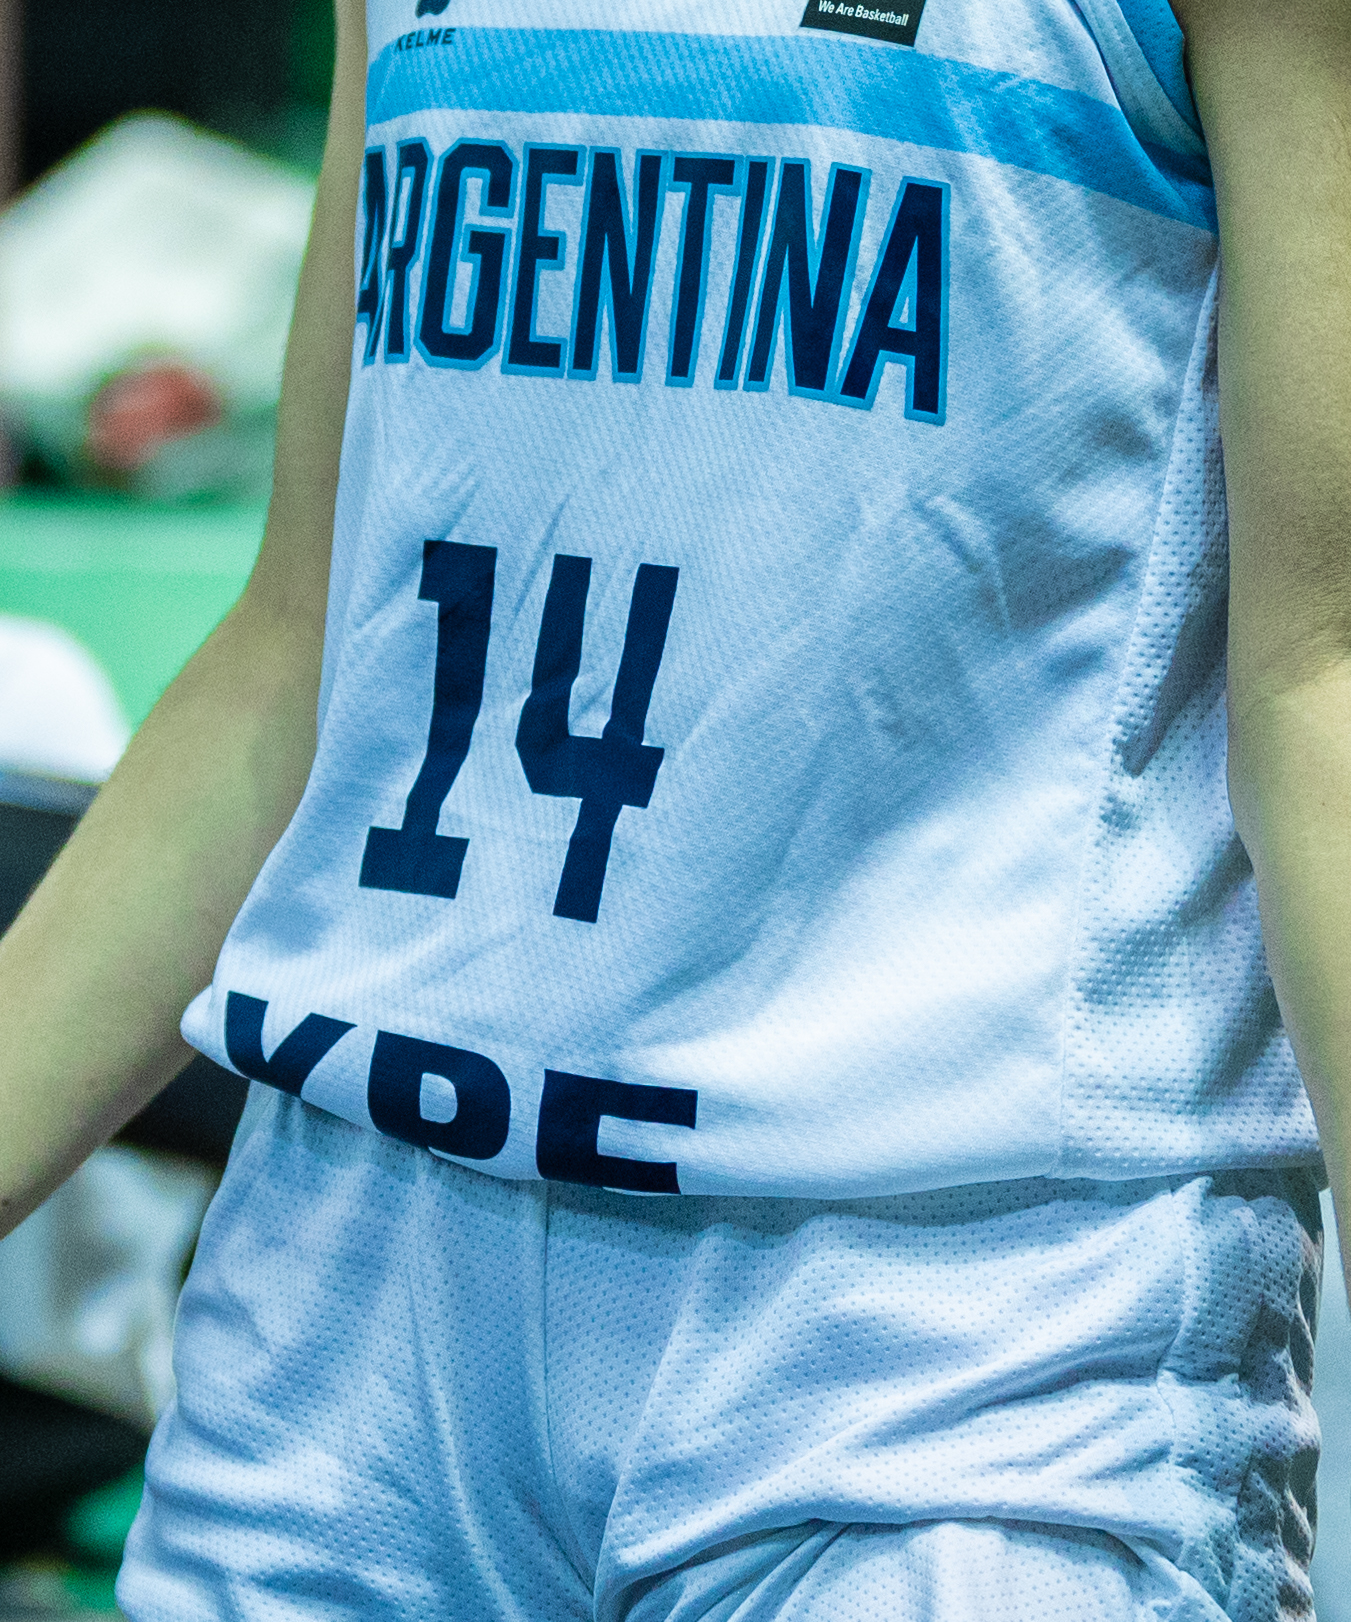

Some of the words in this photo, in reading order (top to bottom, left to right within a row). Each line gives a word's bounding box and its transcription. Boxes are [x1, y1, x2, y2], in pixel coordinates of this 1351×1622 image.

[395, 27, 457, 54] KELME
[818, 0, 835, 14] We
[835, 2, 855, 17] Are
[854, 4, 910, 27] Basketball
[354, 135, 951, 425] ARGENTINA
[358, 539, 680, 924] 14
